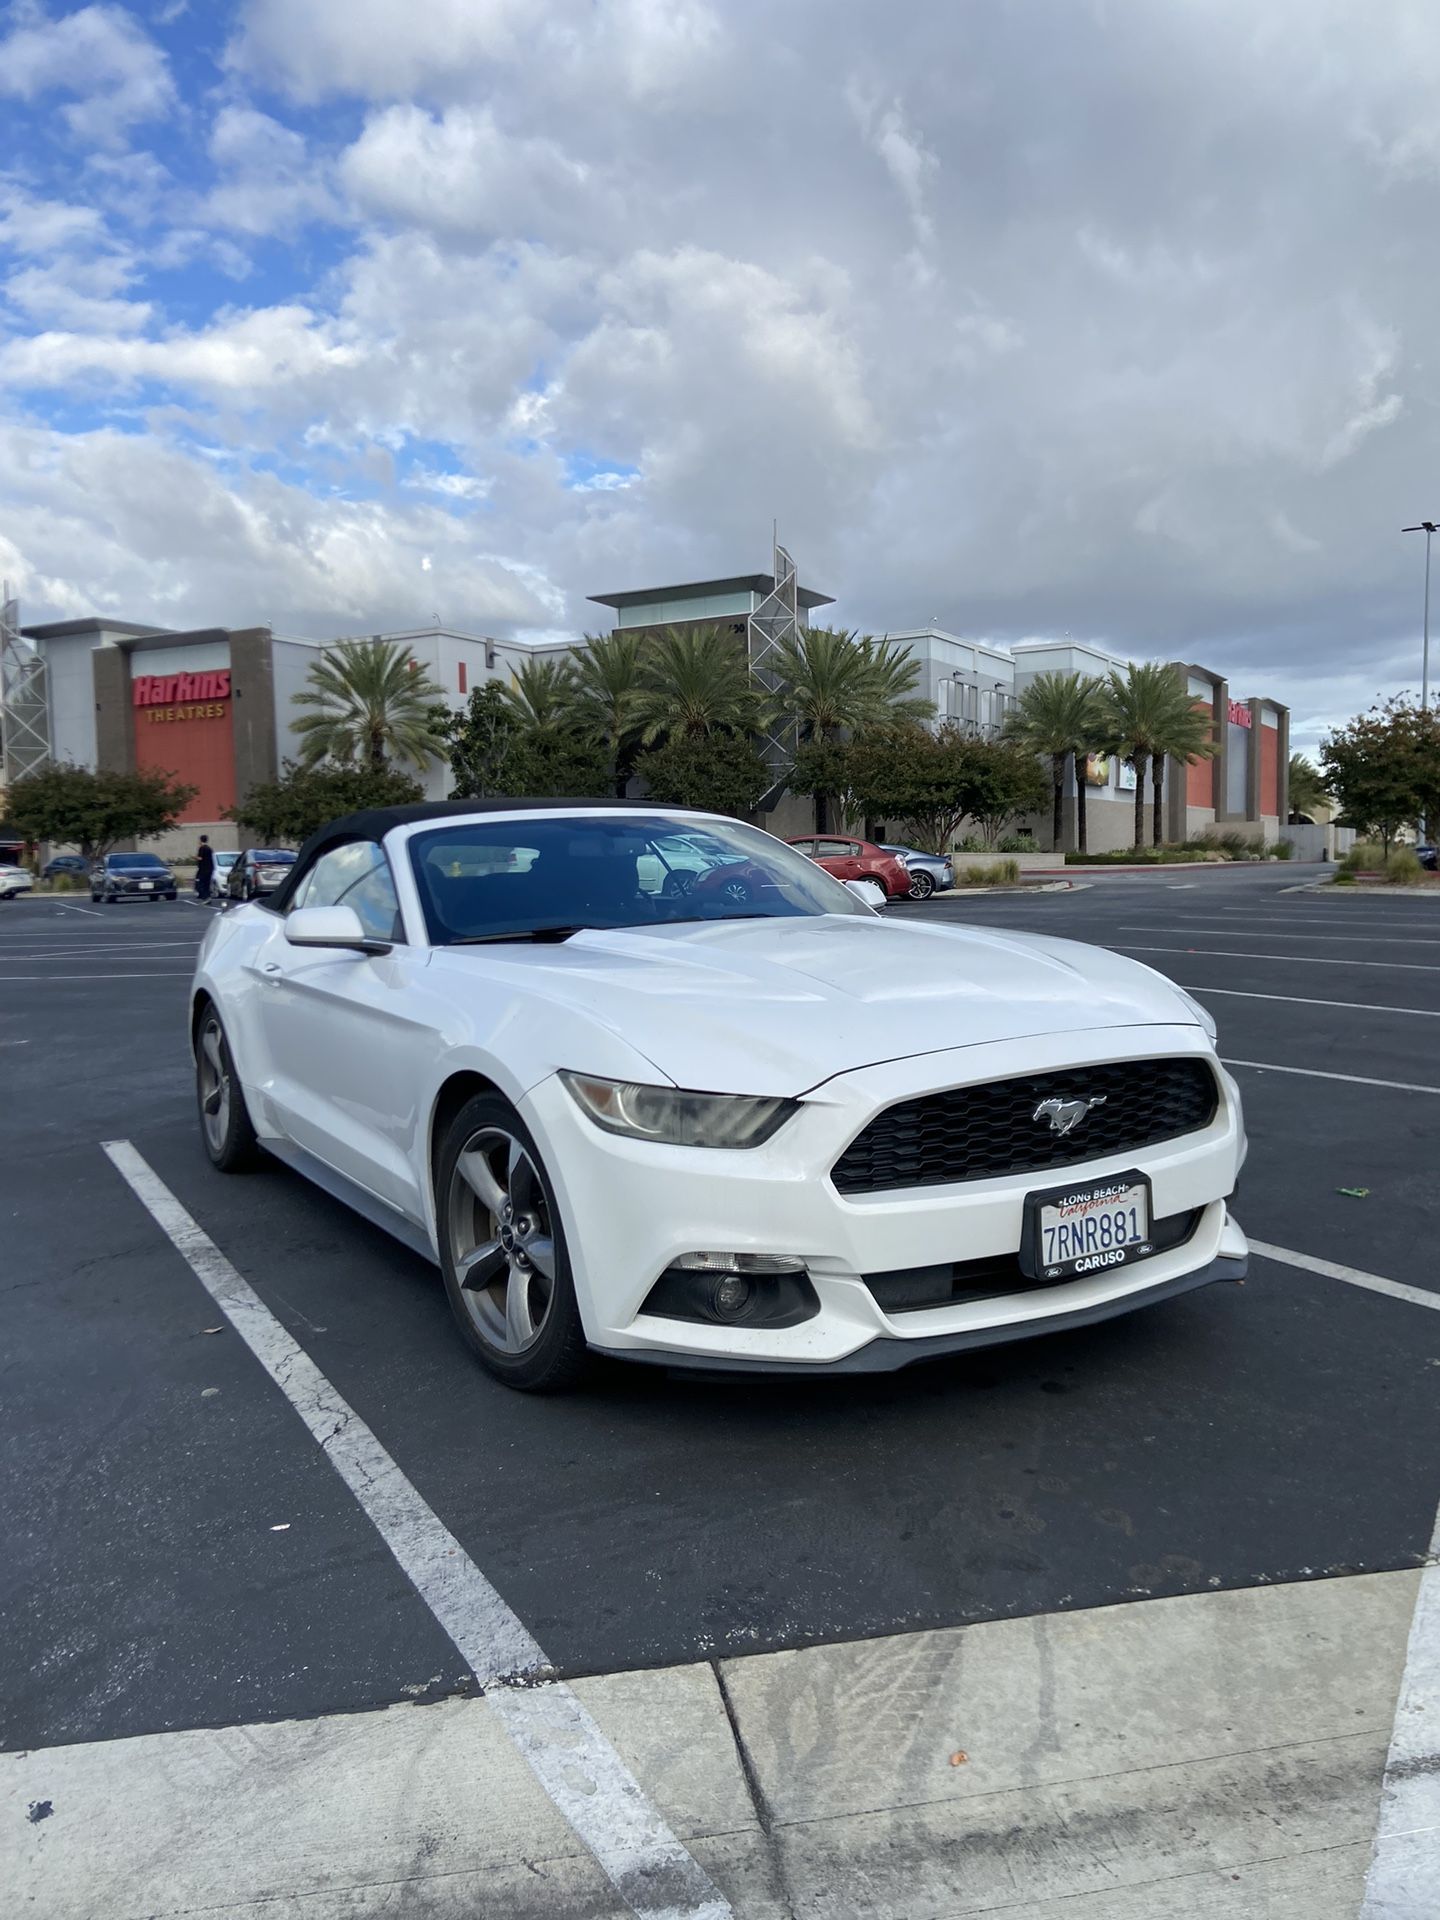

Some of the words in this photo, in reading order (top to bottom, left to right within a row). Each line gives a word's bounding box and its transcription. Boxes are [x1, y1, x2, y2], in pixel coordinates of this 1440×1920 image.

[133, 671, 231, 705] Harkins
[146, 704, 224, 721] THEATRES
[1063, 1194, 1091, 1206] LONG
[1093, 1184, 1125, 1198] BEACH
[1044, 1207, 1141, 1262] 7RNR881
[1075, 1250, 1125, 1272] CARUSO
